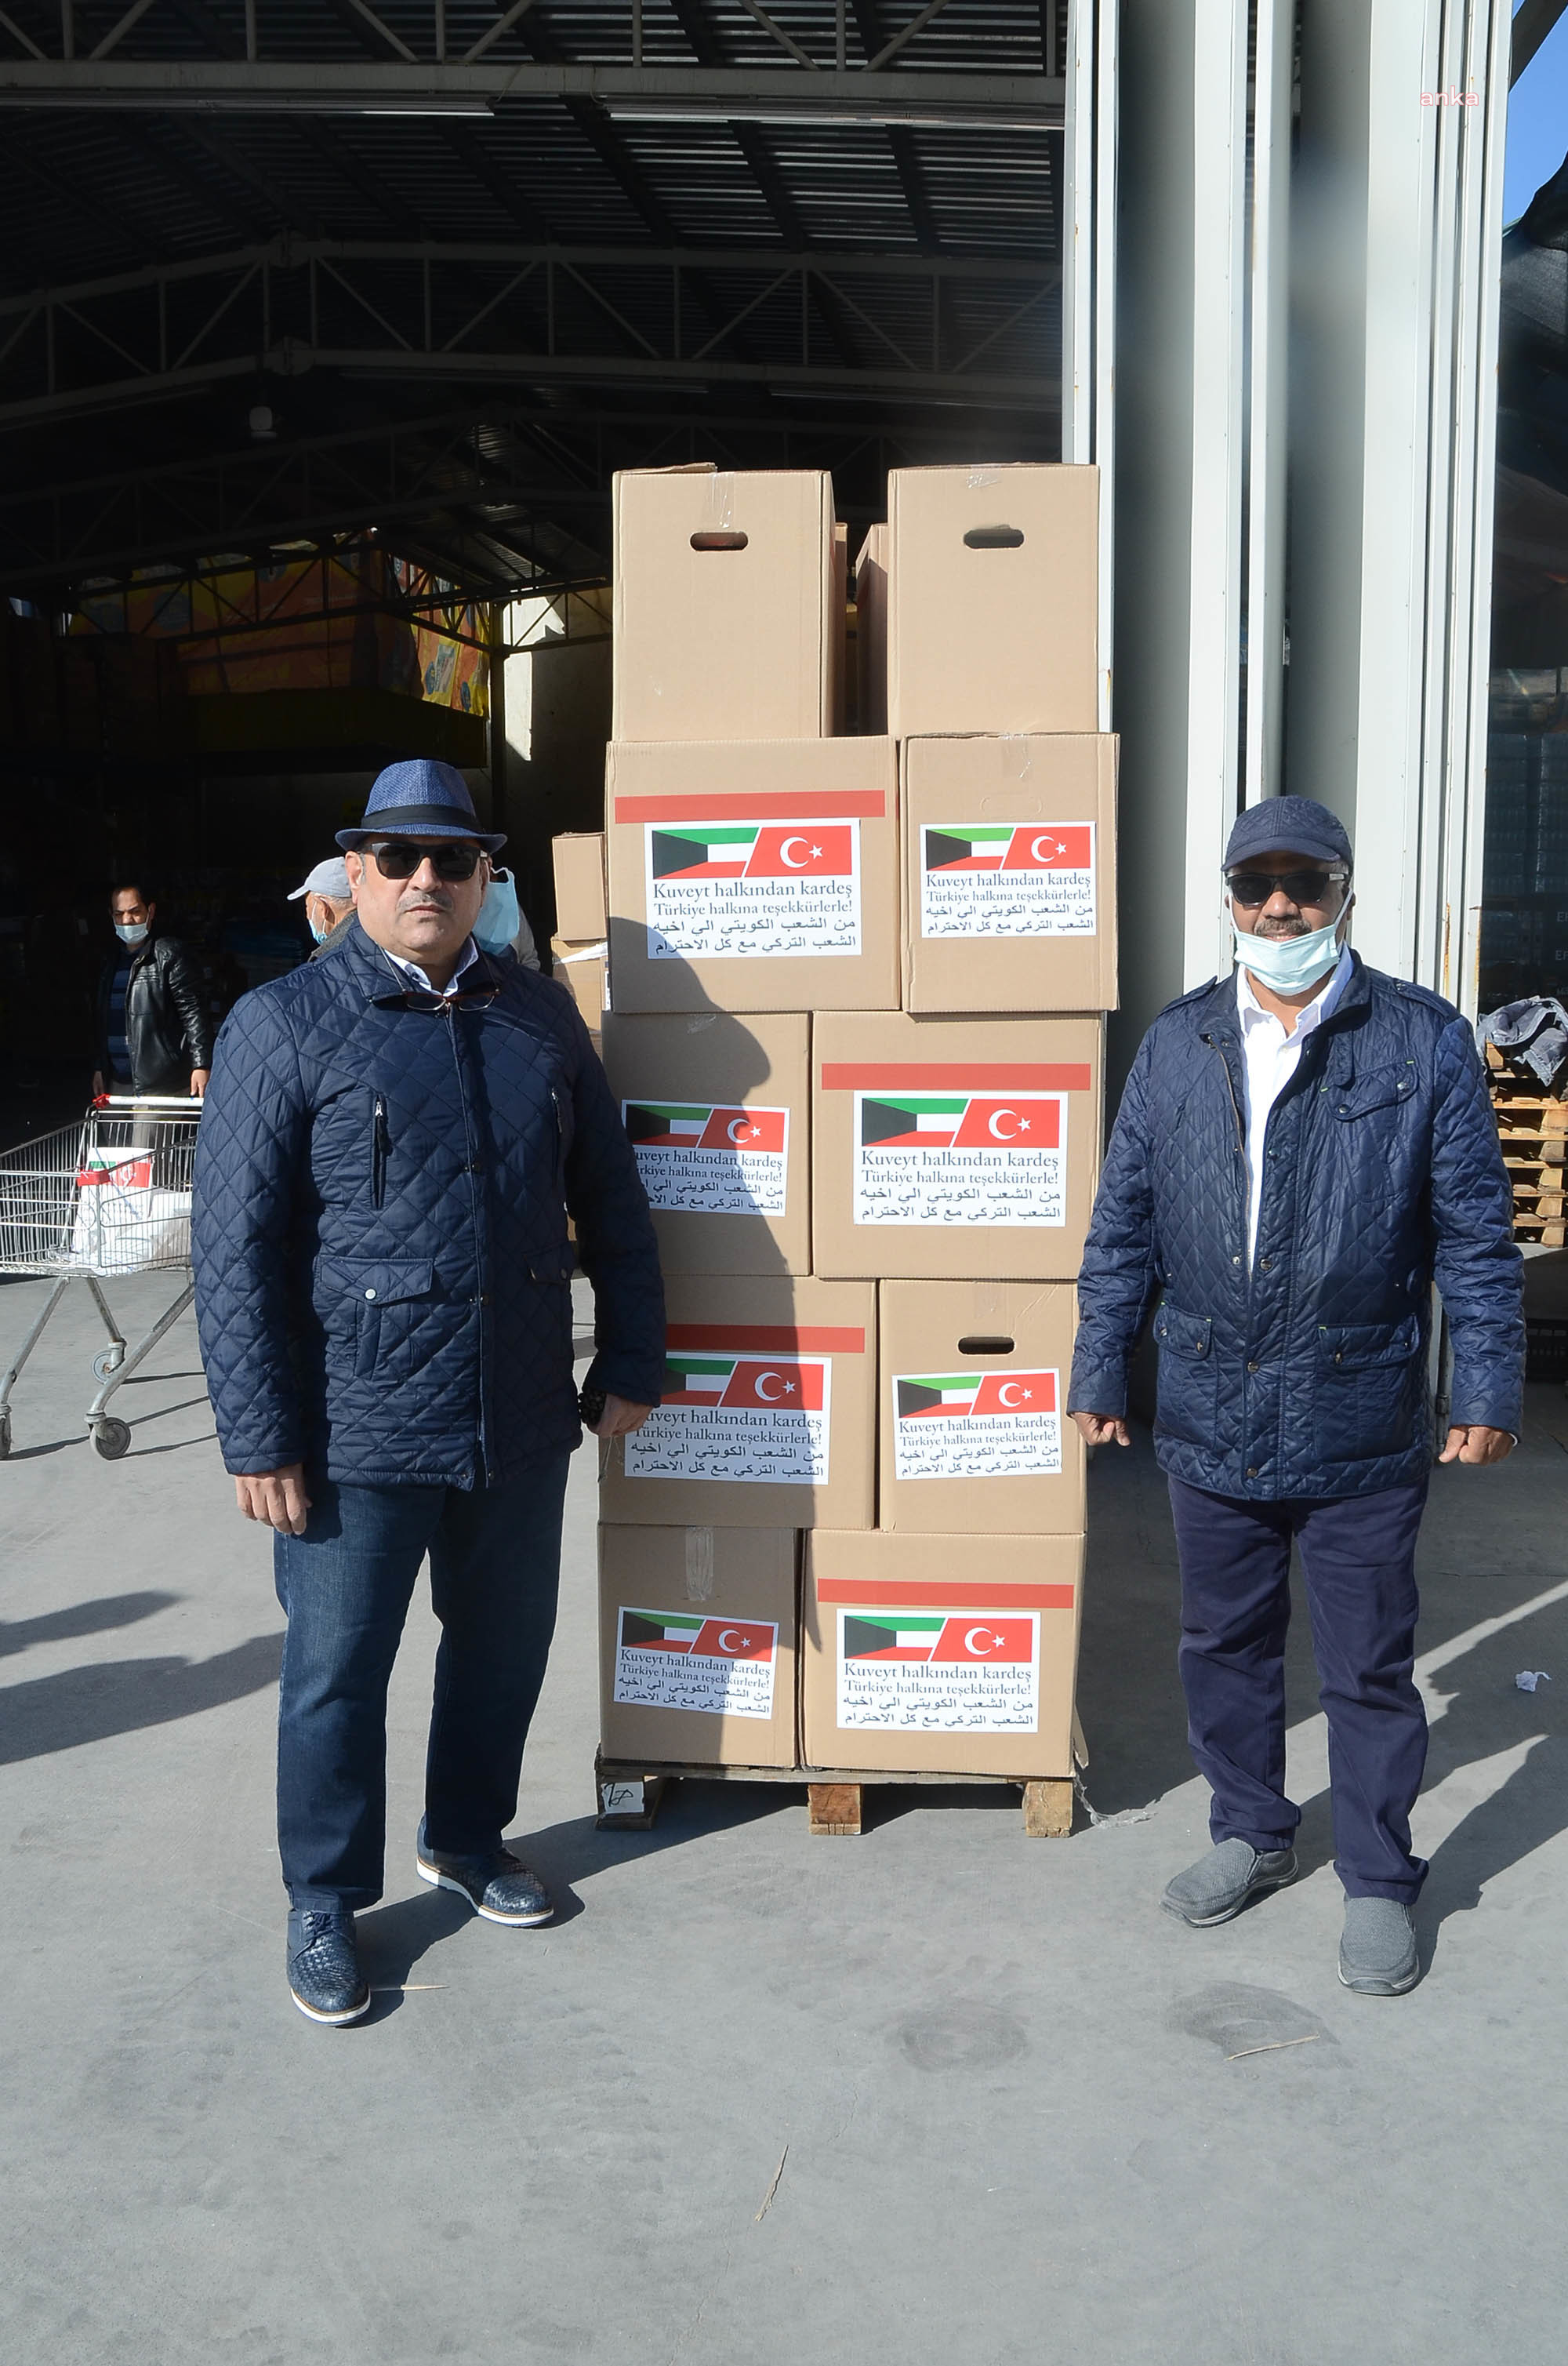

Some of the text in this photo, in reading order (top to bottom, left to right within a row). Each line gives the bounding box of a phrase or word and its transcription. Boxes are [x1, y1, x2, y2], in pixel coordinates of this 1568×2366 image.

[927, 873, 1091, 892] Kuveyt halkından kardeş
[654, 880, 852, 903] Kuveyt halkından kardeş
[926, 889, 1090, 904] Türkiye halkına teşekkürlerle!
[653, 900, 851, 919] Türkiye halkına teşekkürlerle!
[1031, 903, 1069, 916] الشعب
[1075, 905, 1093, 915] من
[780, 917, 826, 932] الشعب
[833, 919, 855, 931] من
[976, 921, 991, 932] كل
[996, 923, 1011, 934] مع
[1057, 919, 1093, 931] الشعب
[714, 939, 731, 951] كل
[738, 940, 756, 953] مع
[812, 936, 855, 949] الشعب
[636, 1150, 782, 1171] uveyt halkından kardeş
[862, 1150, 1058, 1171] Kuveyt halkından kardeş
[637, 1165, 666, 1179] rkiye
[861, 1169, 1058, 1186] Türkiye halkına teşekkürlerle!
[766, 1187, 783, 1197] من
[986, 1189, 1032, 1201] الشعب
[1039, 1190, 1060, 1203] من
[670, 1195, 684, 1205] كل
[920, 1206, 938, 1219] كل
[943, 1209, 962, 1221] مع
[1017, 1208, 1060, 1219] الشعب
[647, 1410, 822, 1432] uveyt halkından kardeş
[899, 1416, 1055, 1437] Kuveyt halkından kardeş
[685, 1427, 731, 1441] halkına
[735, 1431, 821, 1445] teşekkürlerle!
[899, 1430, 1055, 1448] Türkiye halkına teşekkürlerle!
[752, 1448, 796, 1459] الشعب
[803, 1451, 823, 1462] من
[1000, 1445, 1036, 1457] الشعب
[1041, 1446, 1058, 1456] من
[688, 1462, 705, 1473] كل
[948, 1463, 962, 1473] كل
[966, 1464, 981, 1474] مع
[1025, 1459, 1059, 1470] الشعب
[710, 1465, 728, 1477] مع
[782, 1466, 823, 1477] الشعب
[620, 1648, 770, 1678] Kuveyt halkından kardeş
[620, 1663, 659, 1677] Türkiye
[844, 1663, 1031, 1683] Kuveyt halkından kardeş
[844, 1680, 1030, 1696] Türkiye halkına teşekkürlerle!
[663, 1695, 676, 1703] كل
[753, 1692, 770, 1701] من
[963, 1699, 1006, 1710] الشعب
[1012, 1701, 1033, 1711] من
[900, 1714, 916, 1725] كل
[922, 1716, 939, 1727] مع
[992, 1716, 1033, 1726] الشعب
